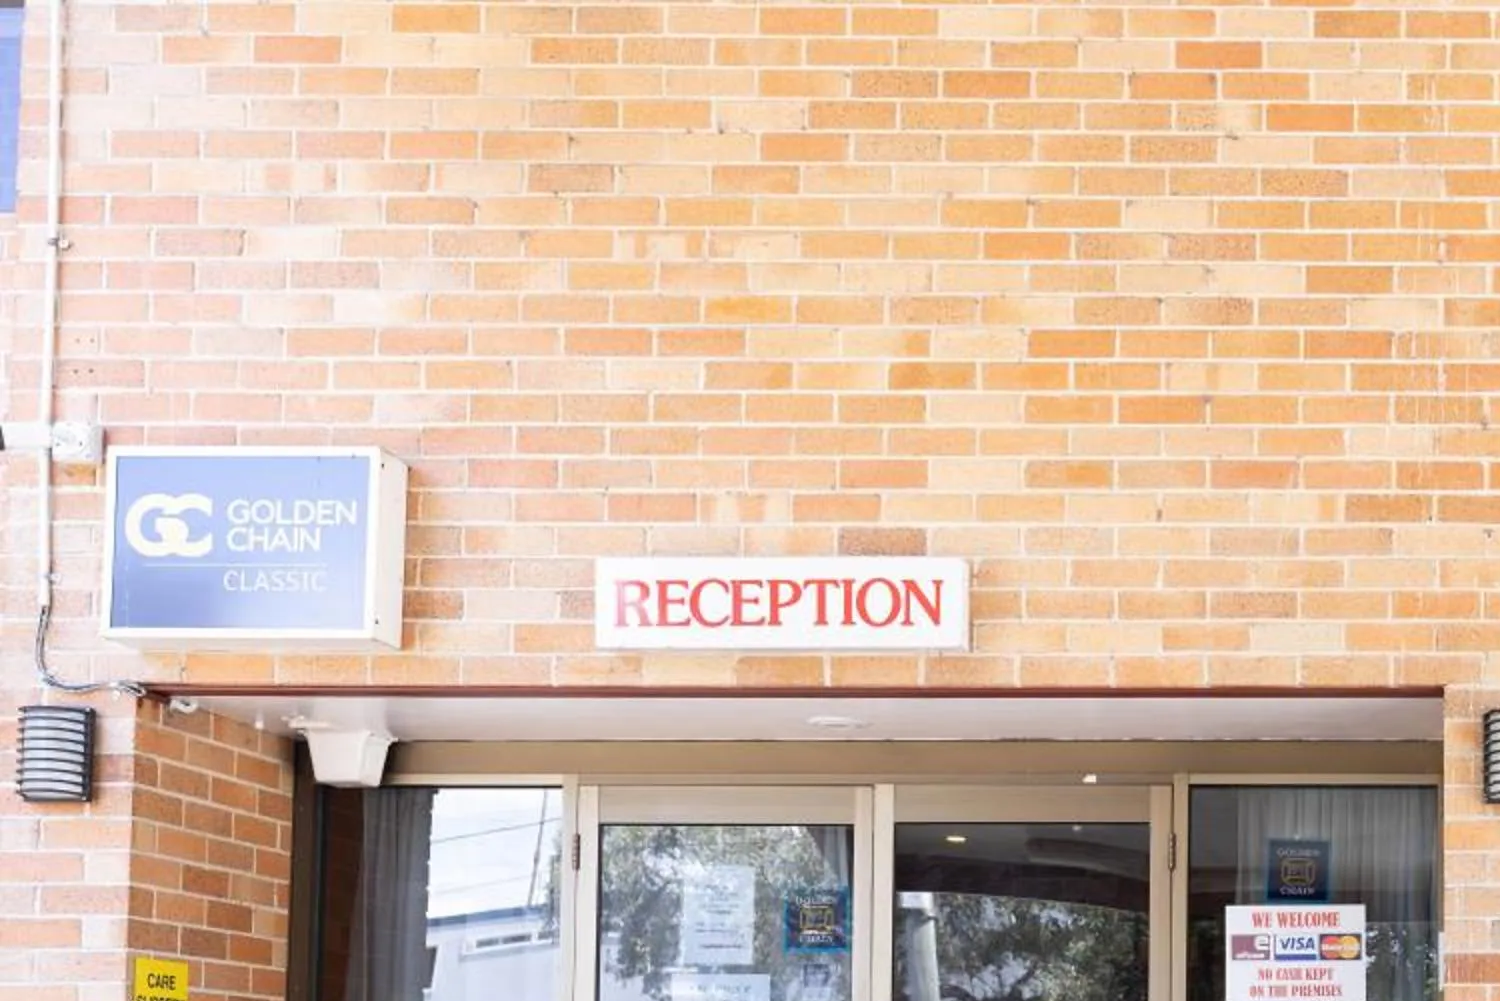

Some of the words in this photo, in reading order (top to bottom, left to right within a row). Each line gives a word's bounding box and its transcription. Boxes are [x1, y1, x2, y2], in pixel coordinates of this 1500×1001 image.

[226, 499, 358, 526] GOLDEN
[226, 527, 321, 552] CHAIN
[223, 570, 327, 592] CLASSIC
[613, 577, 944, 627] RECEPTION
[1251, 911, 1272, 928] WE
[1277, 911, 1340, 928] WELCOME
[1279, 937, 1316, 950] VISA
[147, 973, 176, 990] CARE
[1258, 967, 1273, 981] NO
[1276, 967, 1303, 981] CASH
[1306, 967, 1335, 981] KEPT
[1249, 985, 1265, 998] ON
[1269, 985, 1287, 998] THE
[1291, 984, 1343, 997] PREMISES
